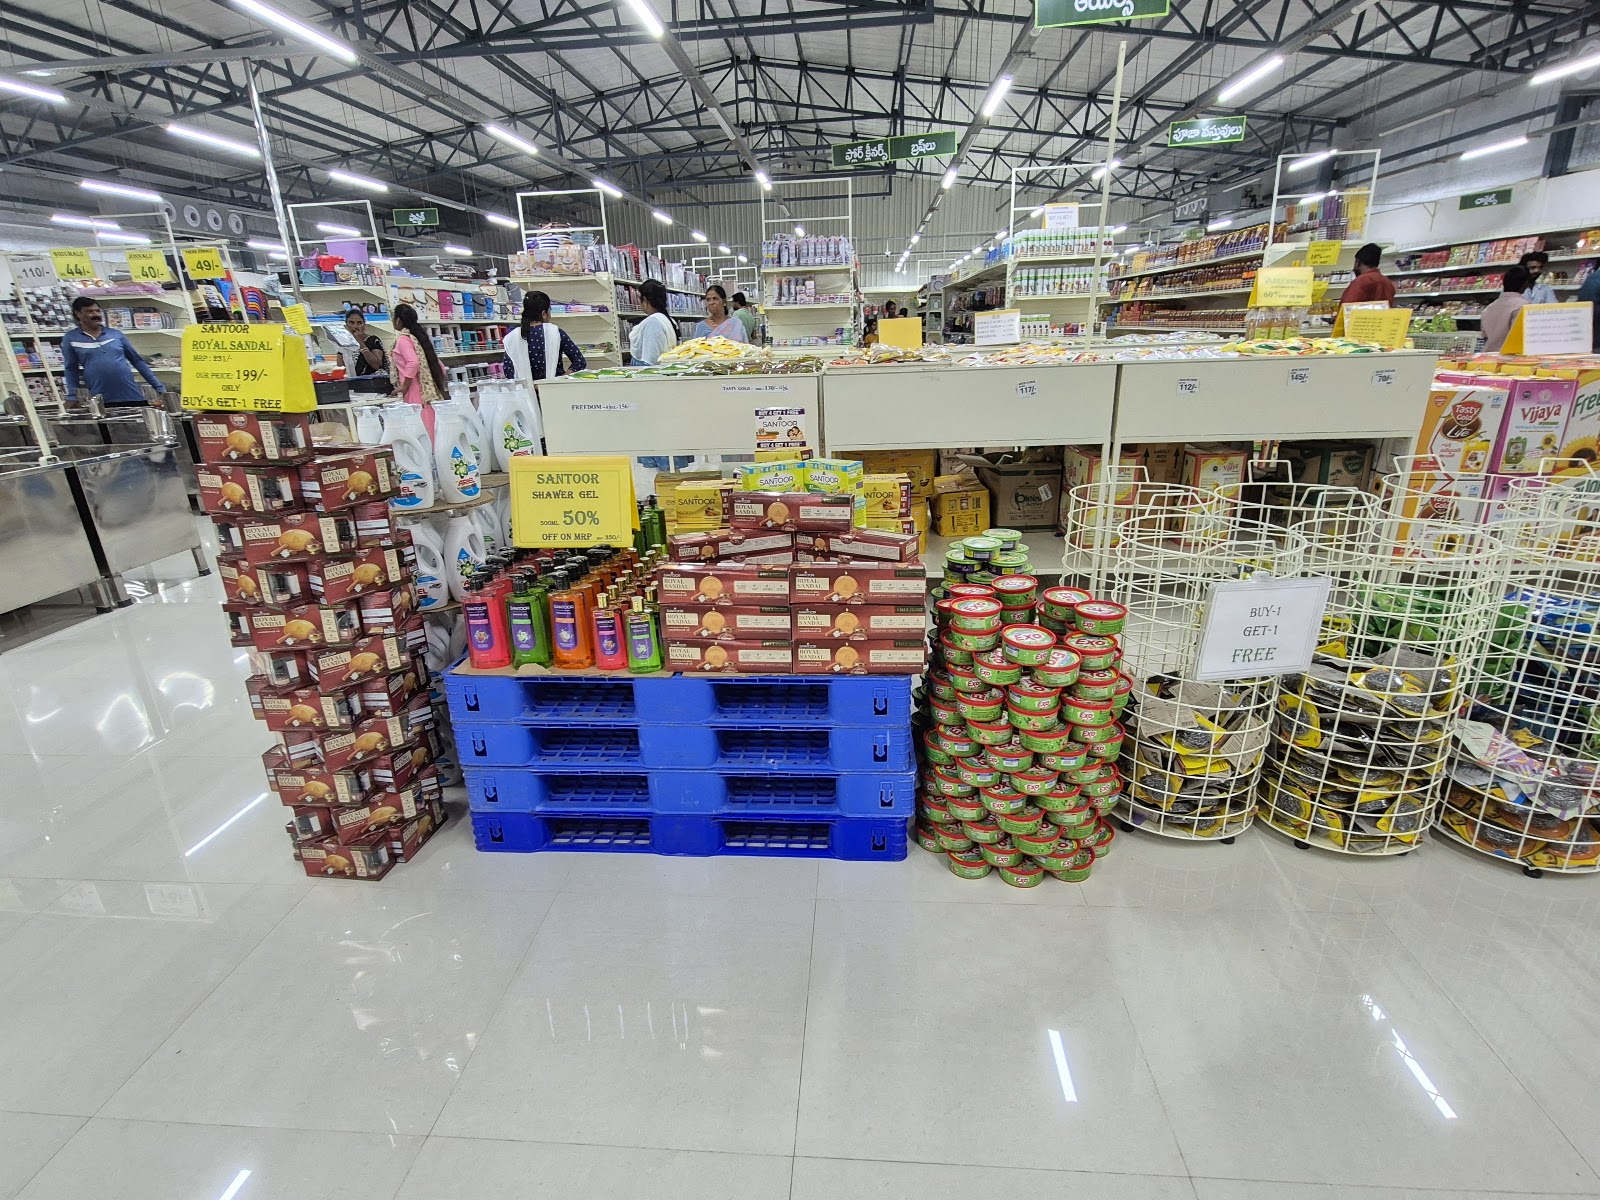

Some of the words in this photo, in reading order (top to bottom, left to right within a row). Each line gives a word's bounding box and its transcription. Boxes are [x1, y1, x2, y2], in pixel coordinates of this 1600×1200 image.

[66, 264, 90, 276] 44/-
[196, 260, 219, 271] 49/-
[141, 266, 164, 278] 40/-
[201, 324, 250, 334] SANTOOR
[192, 339, 227, 350] ROYAL
[230, 341, 272, 350] SANDAL
[236, 369, 268, 381] 199/-
[217, 398, 247, 408] GET-1
[253, 399, 281, 409] FREE
[1455, 405, 1480, 415] Tasty
[1521, 404, 1562, 424] Vijaya
[458, 477, 475, 487] ARIEL
[536, 473, 600, 485] SANTOOR
[760, 475, 794, 485] SANTOOR
[809, 474, 839, 484] SANTOOR
[532, 490, 574, 499] SHAWER
[579, 491, 599, 499] GEL
[863, 491, 894, 499] ANTOOR
[678, 498, 716, 506] SANTOOR
[563, 510, 600, 526] 50%
[542, 533, 558, 541] OFF
[560, 533, 573, 541] ON
[574, 533, 592, 541] MRP
[1249, 605, 1282, 618] BUY-1
[1243, 625, 1278, 637] GET-1
[1014, 633, 1042, 641] Exo
[1075, 638, 1106, 646] Exo
[1232, 647, 1277, 663] FREE
[967, 680, 980, 688] Exo
[1079, 712, 1093, 720] Exo
[1082, 730, 1096, 738] Exo
